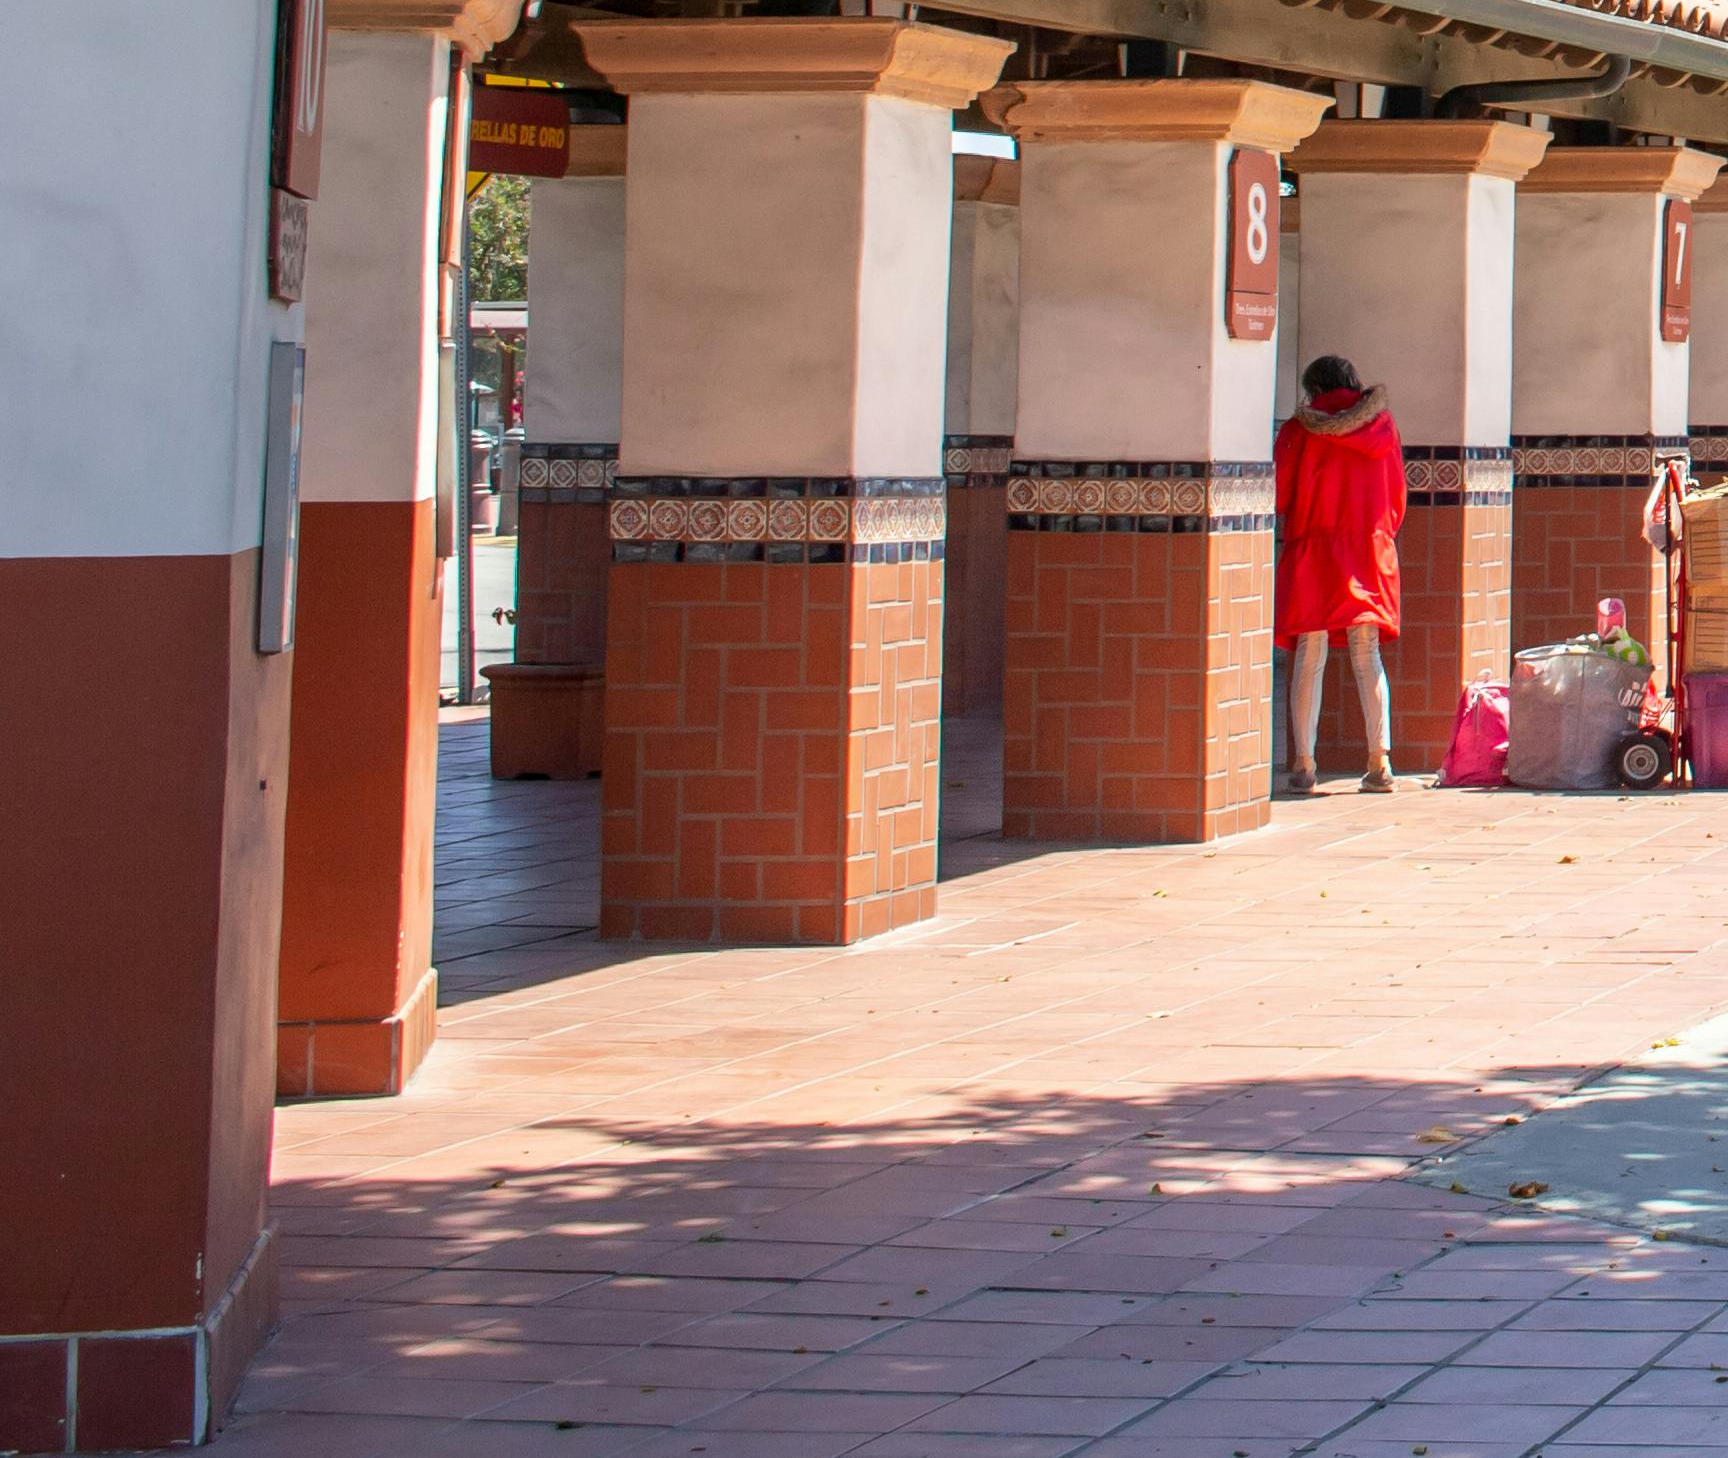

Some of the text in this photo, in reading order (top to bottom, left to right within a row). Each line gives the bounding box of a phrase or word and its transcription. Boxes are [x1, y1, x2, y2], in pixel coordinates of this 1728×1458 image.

[520, 124, 537, 147] DE
[540, 126, 565, 150] ORO
[1246, 181, 1268, 265] 8
[1674, 221, 1688, 286] 7
